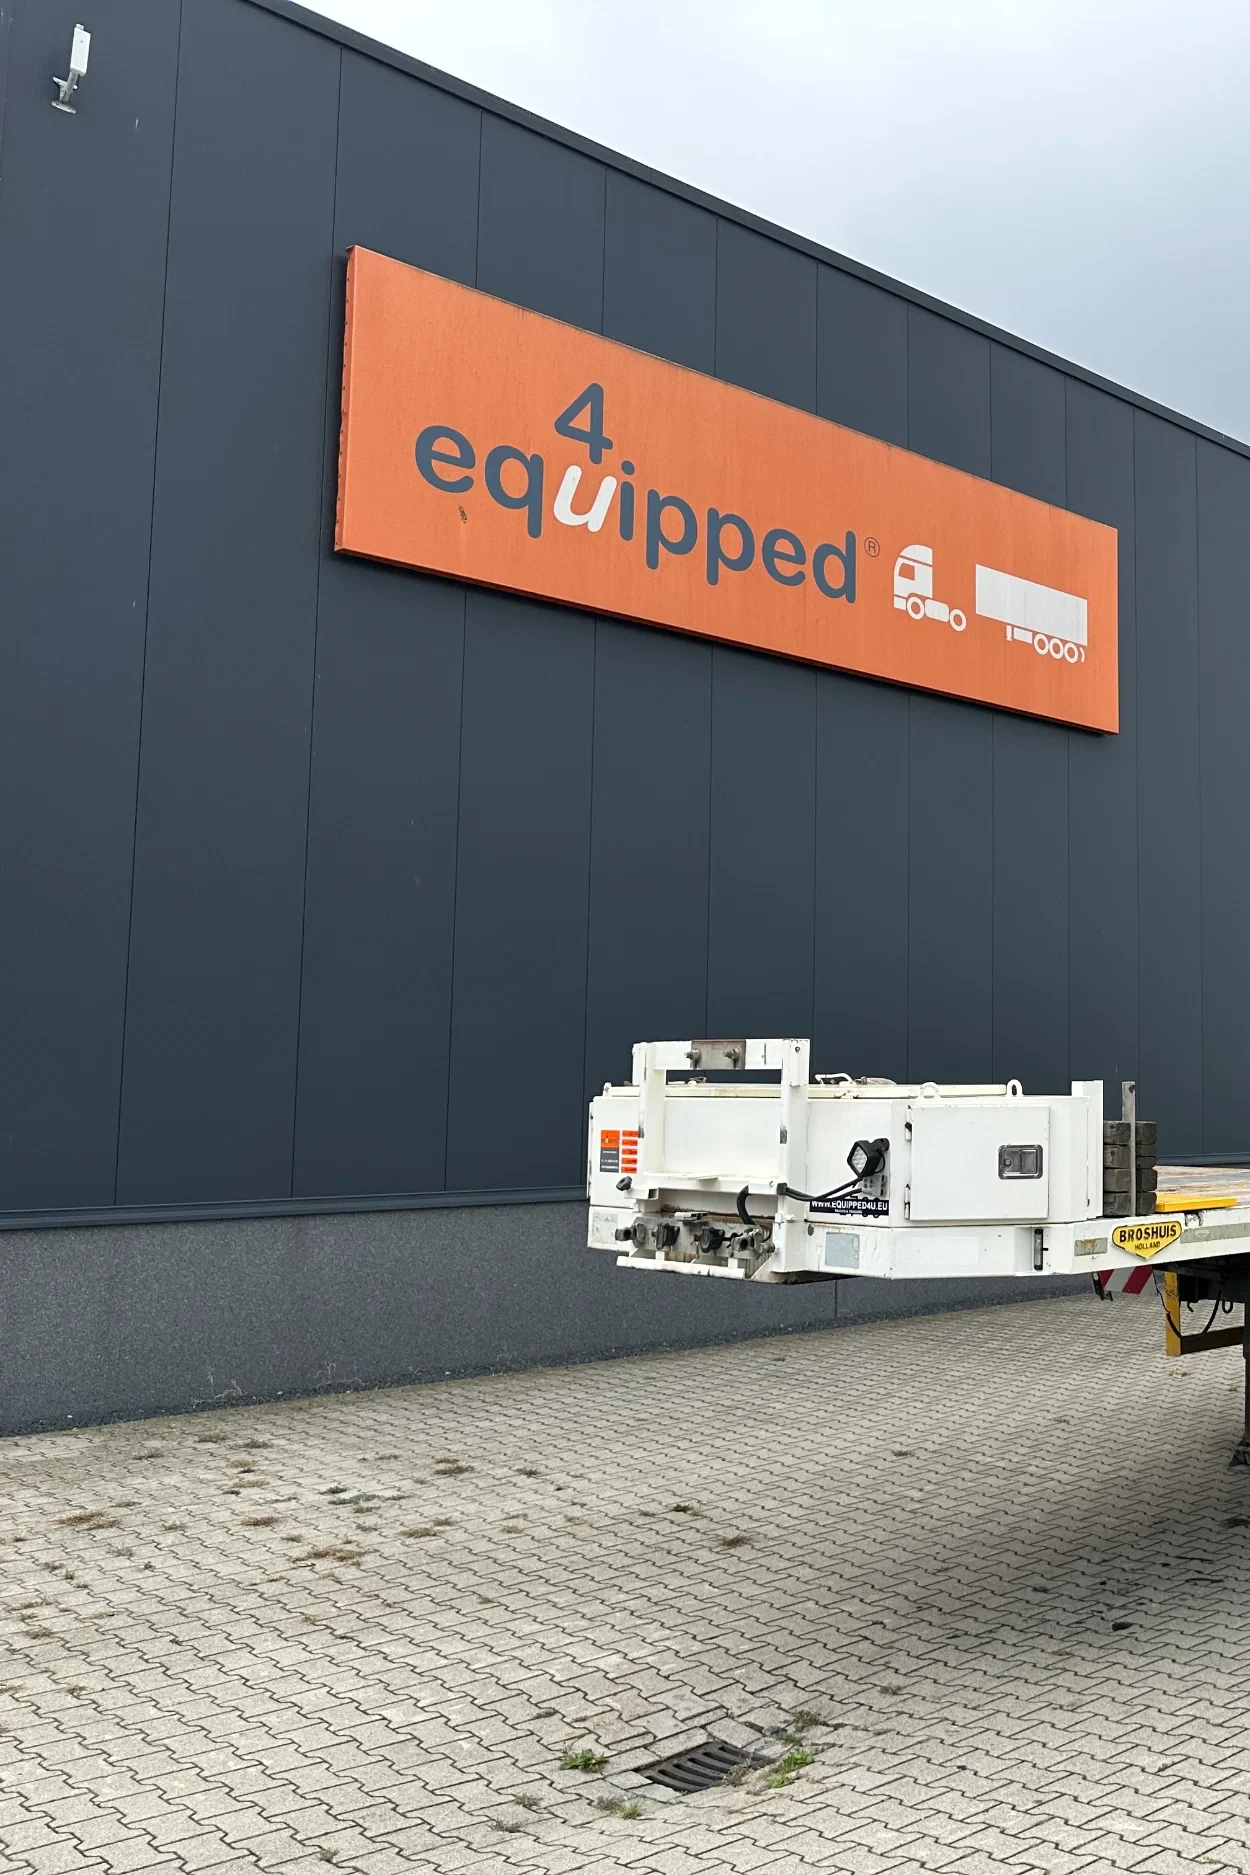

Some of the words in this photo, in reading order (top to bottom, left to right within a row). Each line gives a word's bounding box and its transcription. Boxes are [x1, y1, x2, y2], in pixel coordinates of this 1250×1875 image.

[554, 382, 614, 464] 4
[1119, 1224, 1177, 1243] BROSHUIS
[1134, 1241, 1161, 1250] HOLLAND
